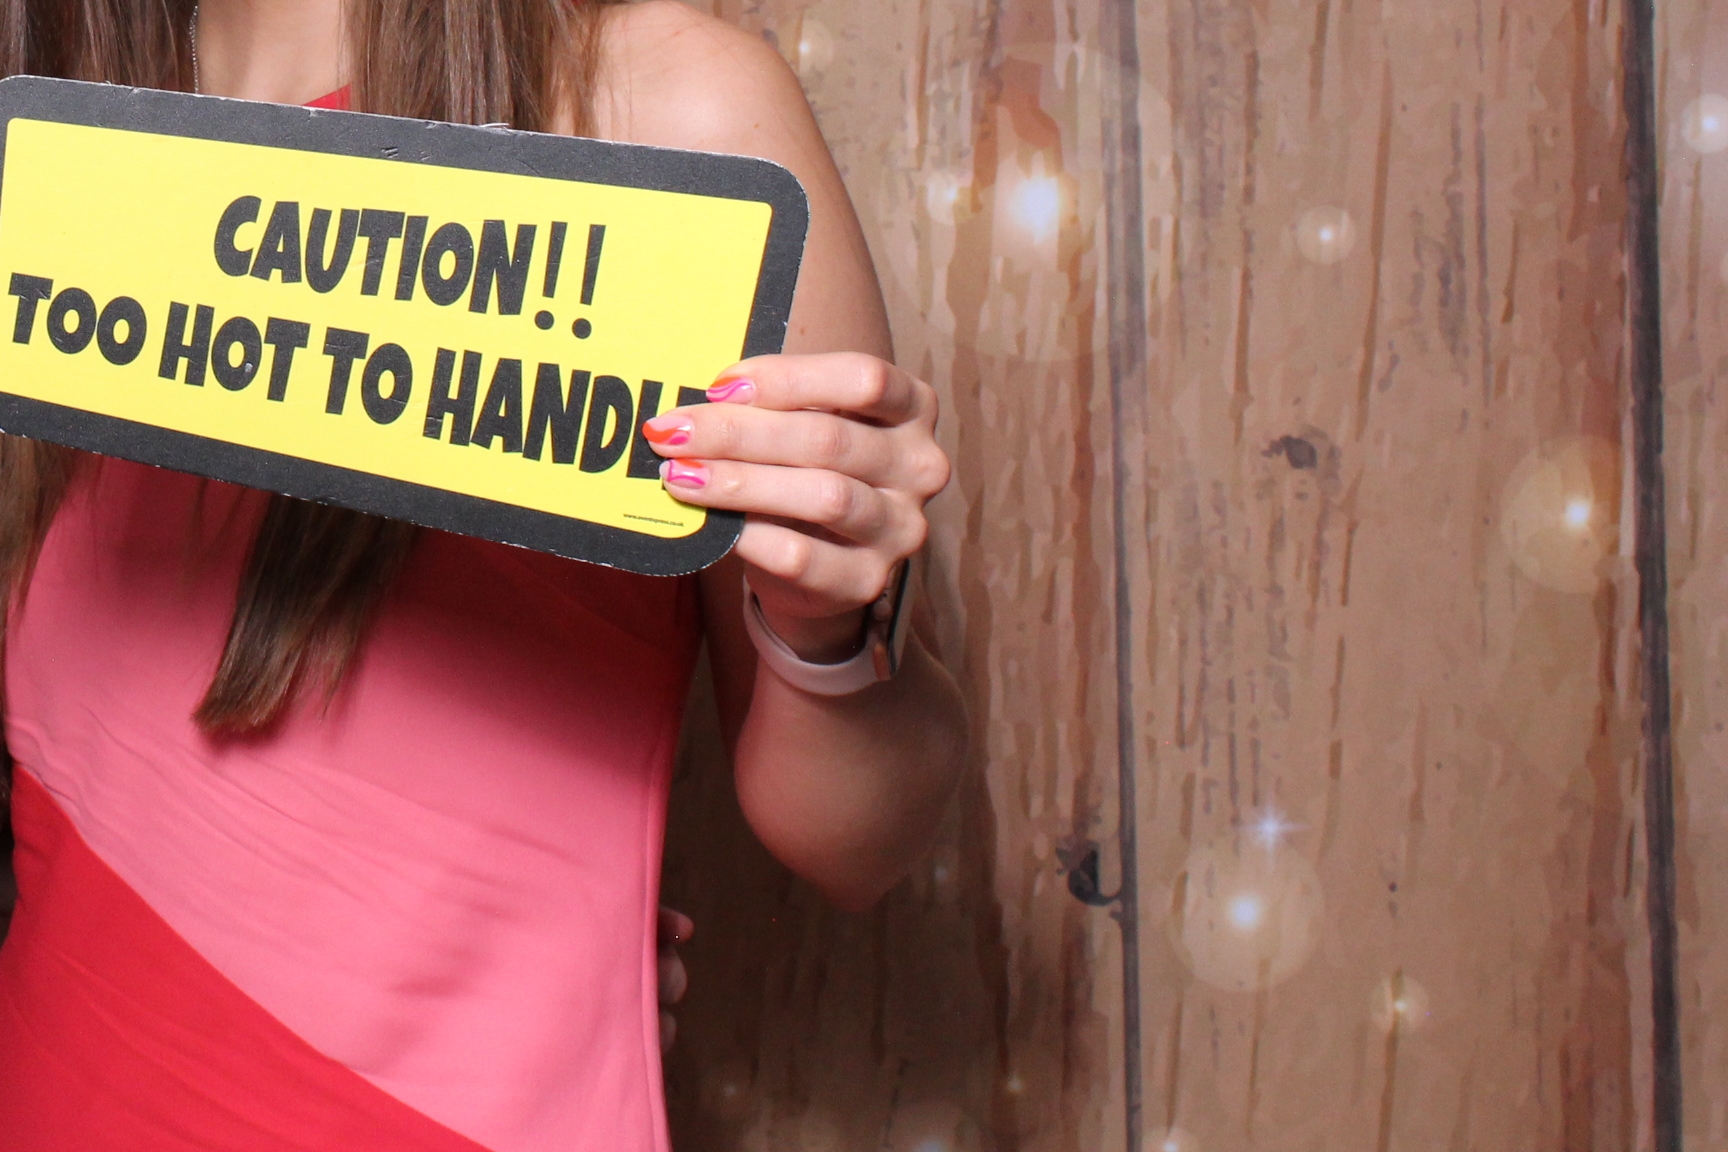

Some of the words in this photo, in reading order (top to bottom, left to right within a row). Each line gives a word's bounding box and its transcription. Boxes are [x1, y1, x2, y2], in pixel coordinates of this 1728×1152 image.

[215, 196, 605, 338] CAUTION!!
[8, 273, 147, 365] TOO
[158, 302, 309, 402] HOT
[323, 328, 412, 425] TO
[422, 348, 710, 491] HANDL
